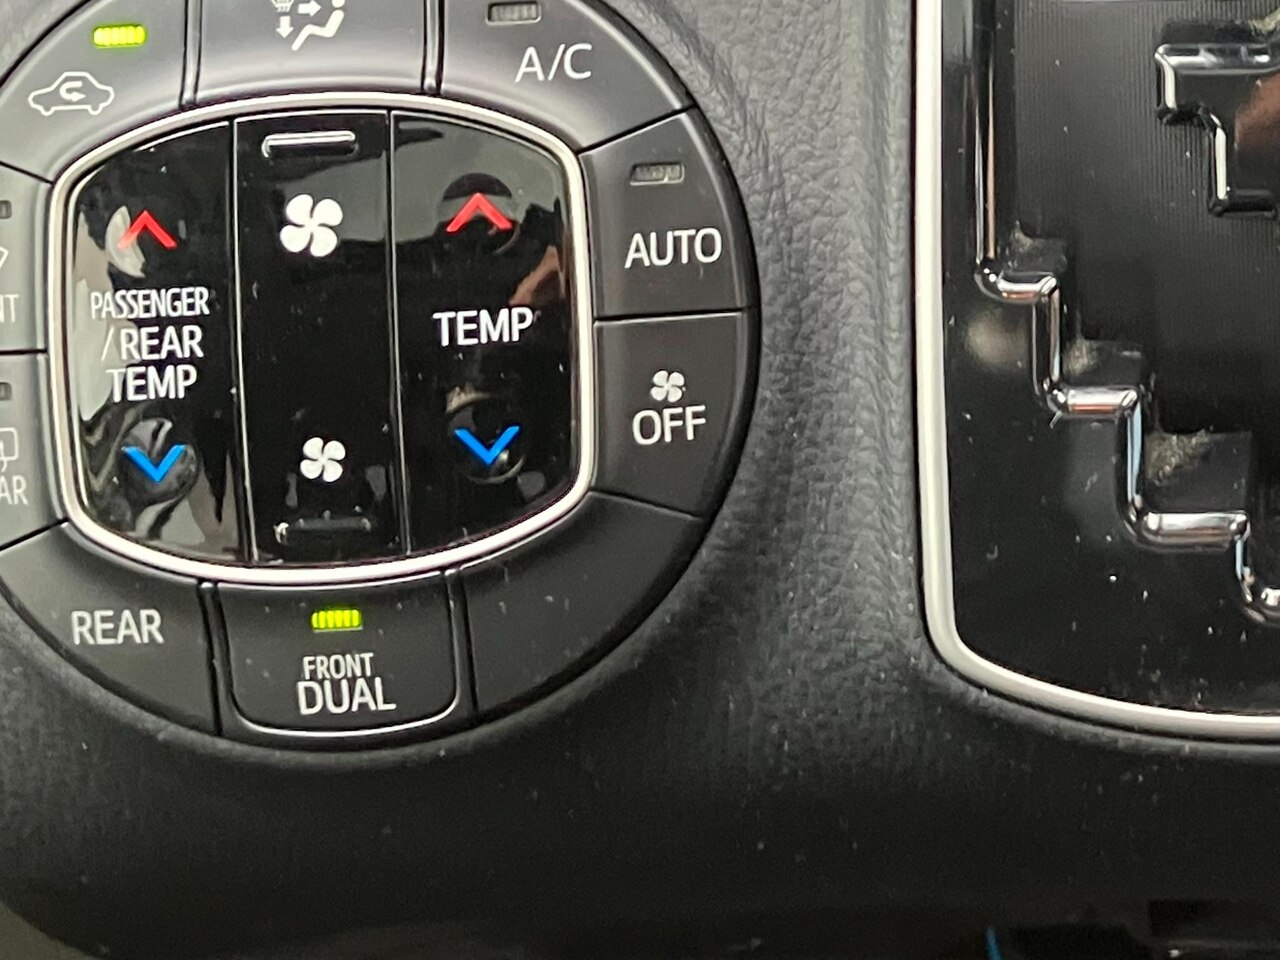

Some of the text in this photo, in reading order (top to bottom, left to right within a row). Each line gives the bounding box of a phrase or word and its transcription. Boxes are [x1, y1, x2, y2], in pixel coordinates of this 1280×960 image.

[515, 44, 593, 83] A/C
[624, 227, 723, 269] AUTO
[90, 286, 211, 320] PASSENGER
[433, 307, 533, 348] TEMP
[105, 364, 198, 403] TEMP
[632, 404, 707, 445] OFF
[71, 608, 164, 646] REAR
[302, 652, 374, 680] FRONT
[297, 676, 397, 715] DUAL
